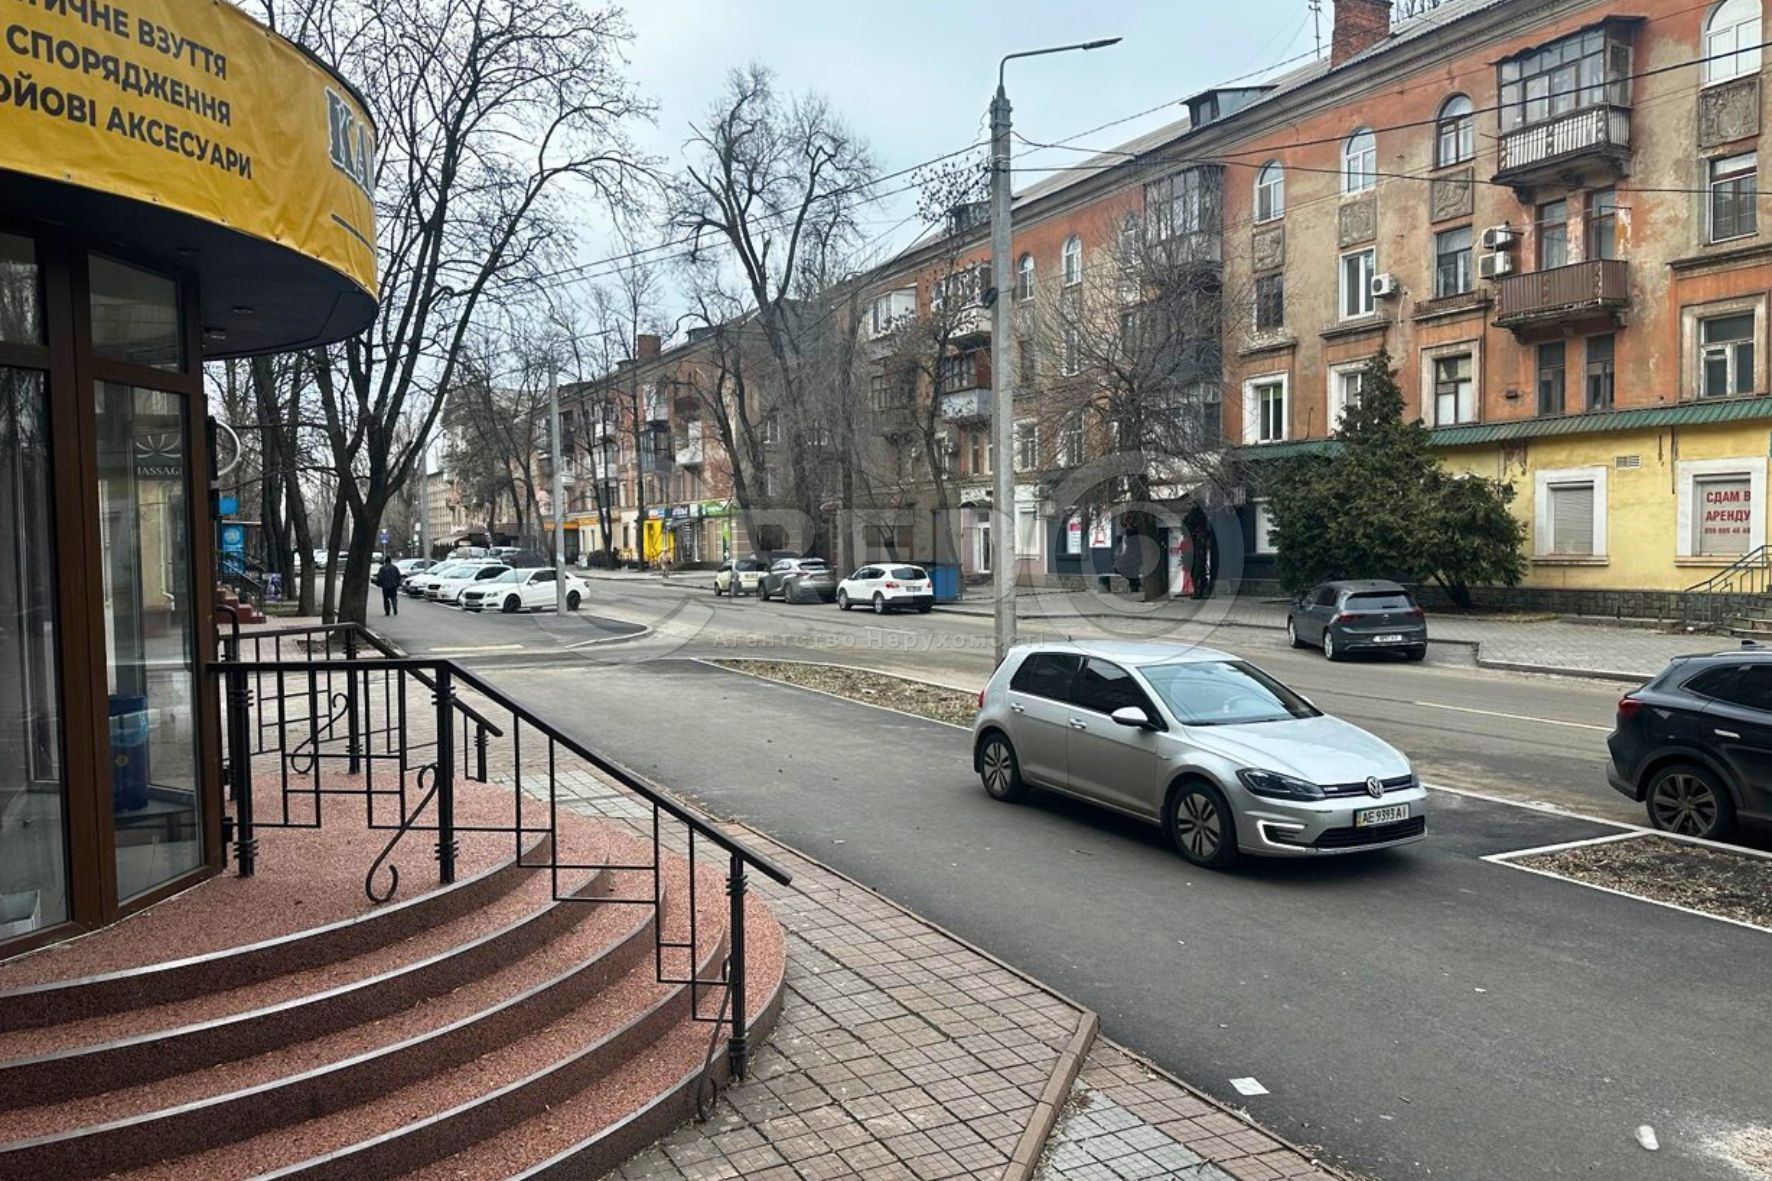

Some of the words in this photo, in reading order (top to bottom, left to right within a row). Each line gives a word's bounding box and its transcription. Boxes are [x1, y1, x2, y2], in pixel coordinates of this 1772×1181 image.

[15, 0, 130, 39] ИЧНЕ
[137, 17, 228, 80] ВЗУТТЯ
[5, 23, 232, 128] СПОРЯДЖЕННЯ
[105, 105, 253, 181] АКСЕСУАРИ
[1705, 509, 1751, 523] АРЕНДУ
[1706, 490, 1740, 504] СДАМ
[1743, 490, 1751, 502] В
[1362, 810, 1375, 824] AE
[1376, 807, 1395, 821] 9393
